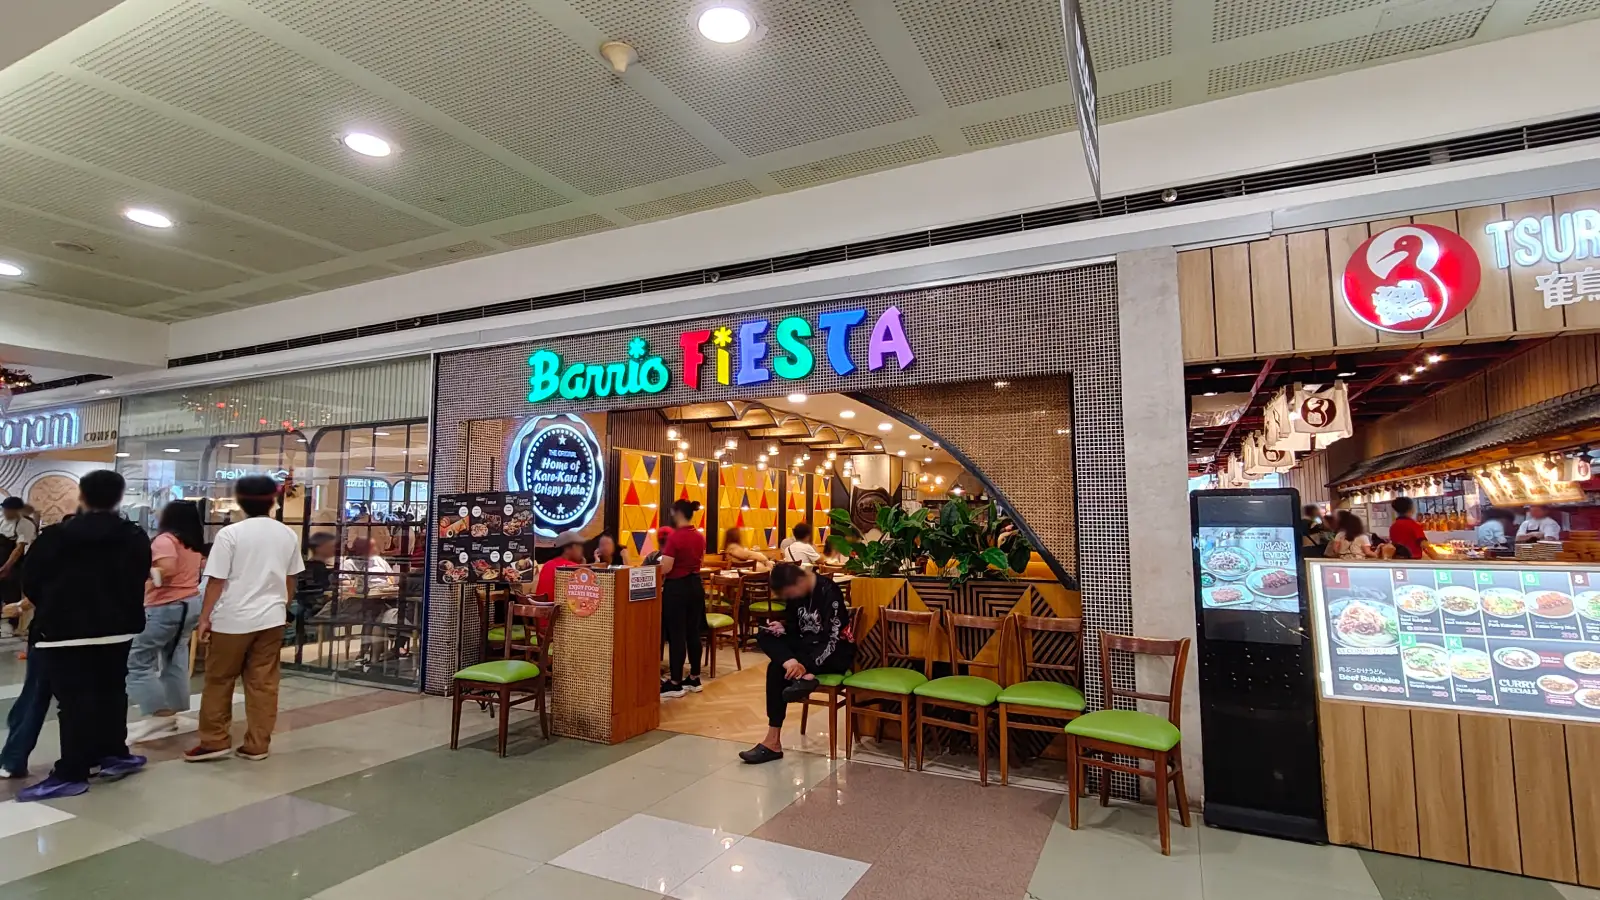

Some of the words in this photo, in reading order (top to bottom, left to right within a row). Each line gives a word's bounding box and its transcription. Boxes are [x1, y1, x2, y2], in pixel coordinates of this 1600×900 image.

[528, 338, 670, 403] Barrio
[541, 458, 568, 471] Home
[570, 460, 581, 473] of
[533, 470, 578, 482] Kare-Kare
[579, 472, 586, 483] &
[533, 483, 563, 497] Crispy
[564, 484, 586, 495] Pata
[1256, 541, 1292, 551] UMAMI
[1264, 551, 1291, 559] EVERY
[1333, 572, 1340, 583] 1
[1396, 571, 1404, 580] 5
[1574, 575, 1584, 584] 8
[1338, 673, 1359, 681] Beef
[1360, 675, 1400, 685] Bukkake
[1499, 679, 1536, 689] CURRY
[1500, 686, 1538, 695] SPECIALS
